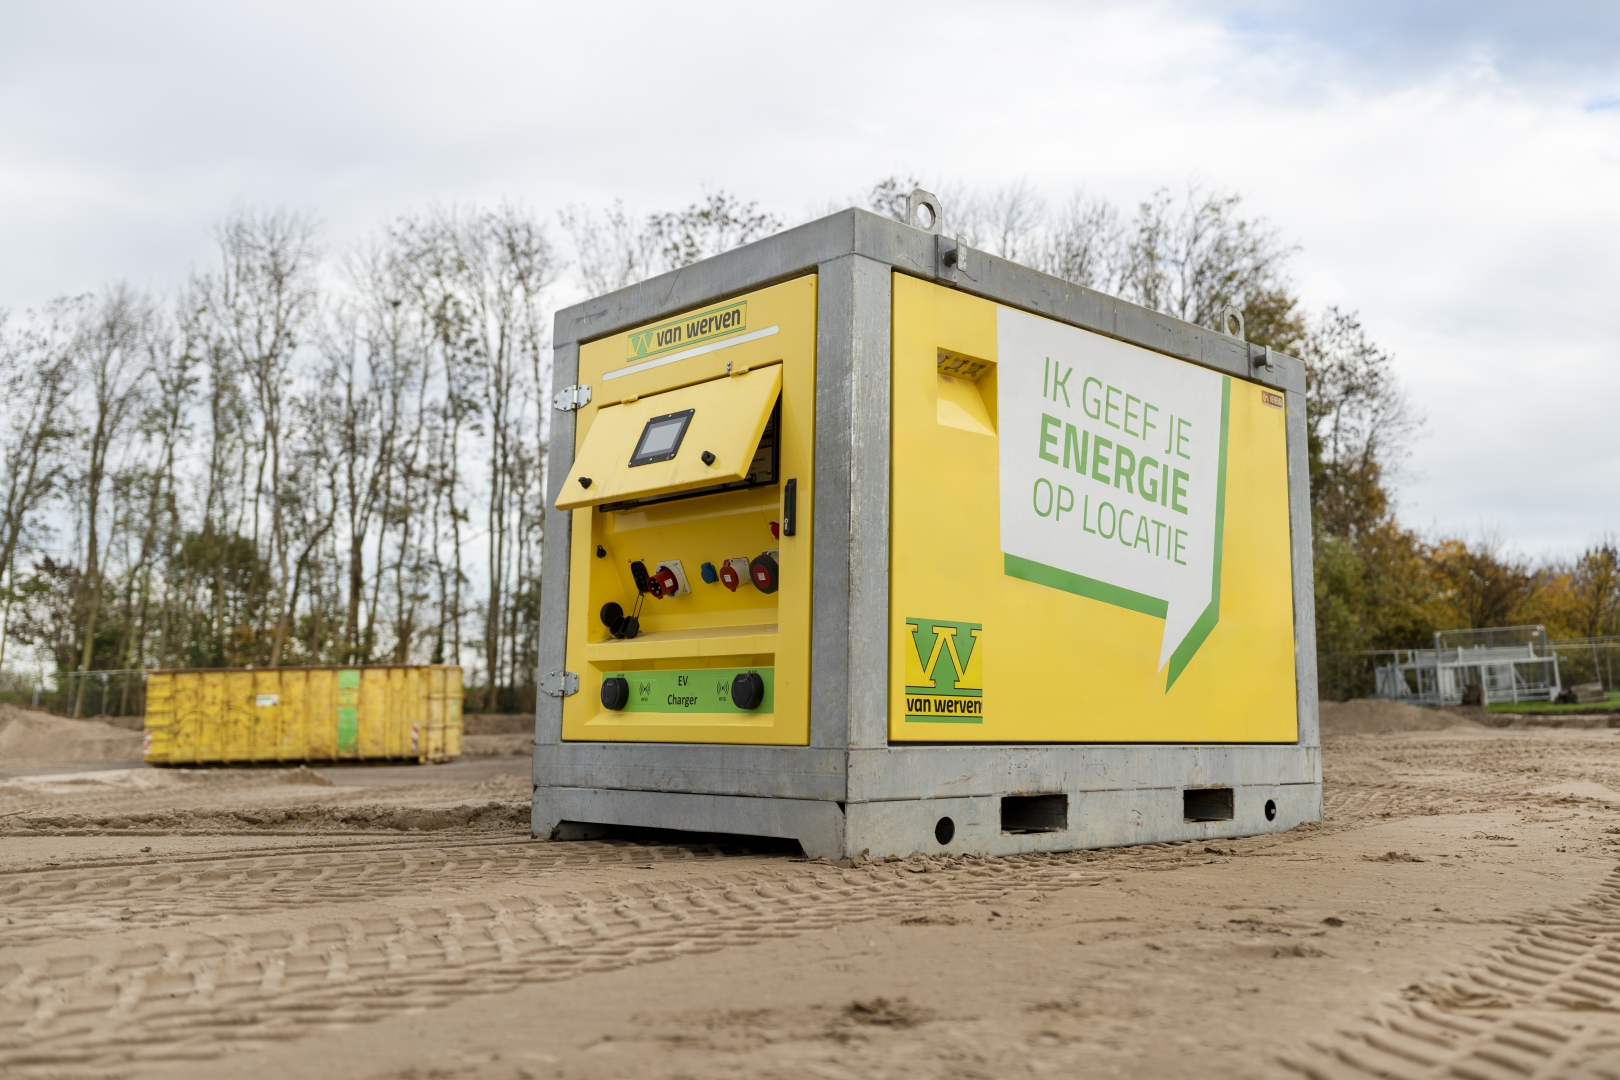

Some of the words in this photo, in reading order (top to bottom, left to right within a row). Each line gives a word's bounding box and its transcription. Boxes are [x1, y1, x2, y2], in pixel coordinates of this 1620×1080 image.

[657, 326, 681, 347] van
[686, 308, 741, 339] werven
[1043, 356, 1073, 408] IK
[1082, 376, 1159, 441] GEEF
[1164, 414, 1192, 461] JE
[1038, 412, 1190, 516] ENERGIE
[1033, 477, 1075, 522] OP
[1082, 494, 1188, 566] LOCATIE
[678, 675, 689, 687] EV
[667, 694, 698, 708] Charger
[906, 698, 931, 713] van
[933, 699, 982, 714] werven
